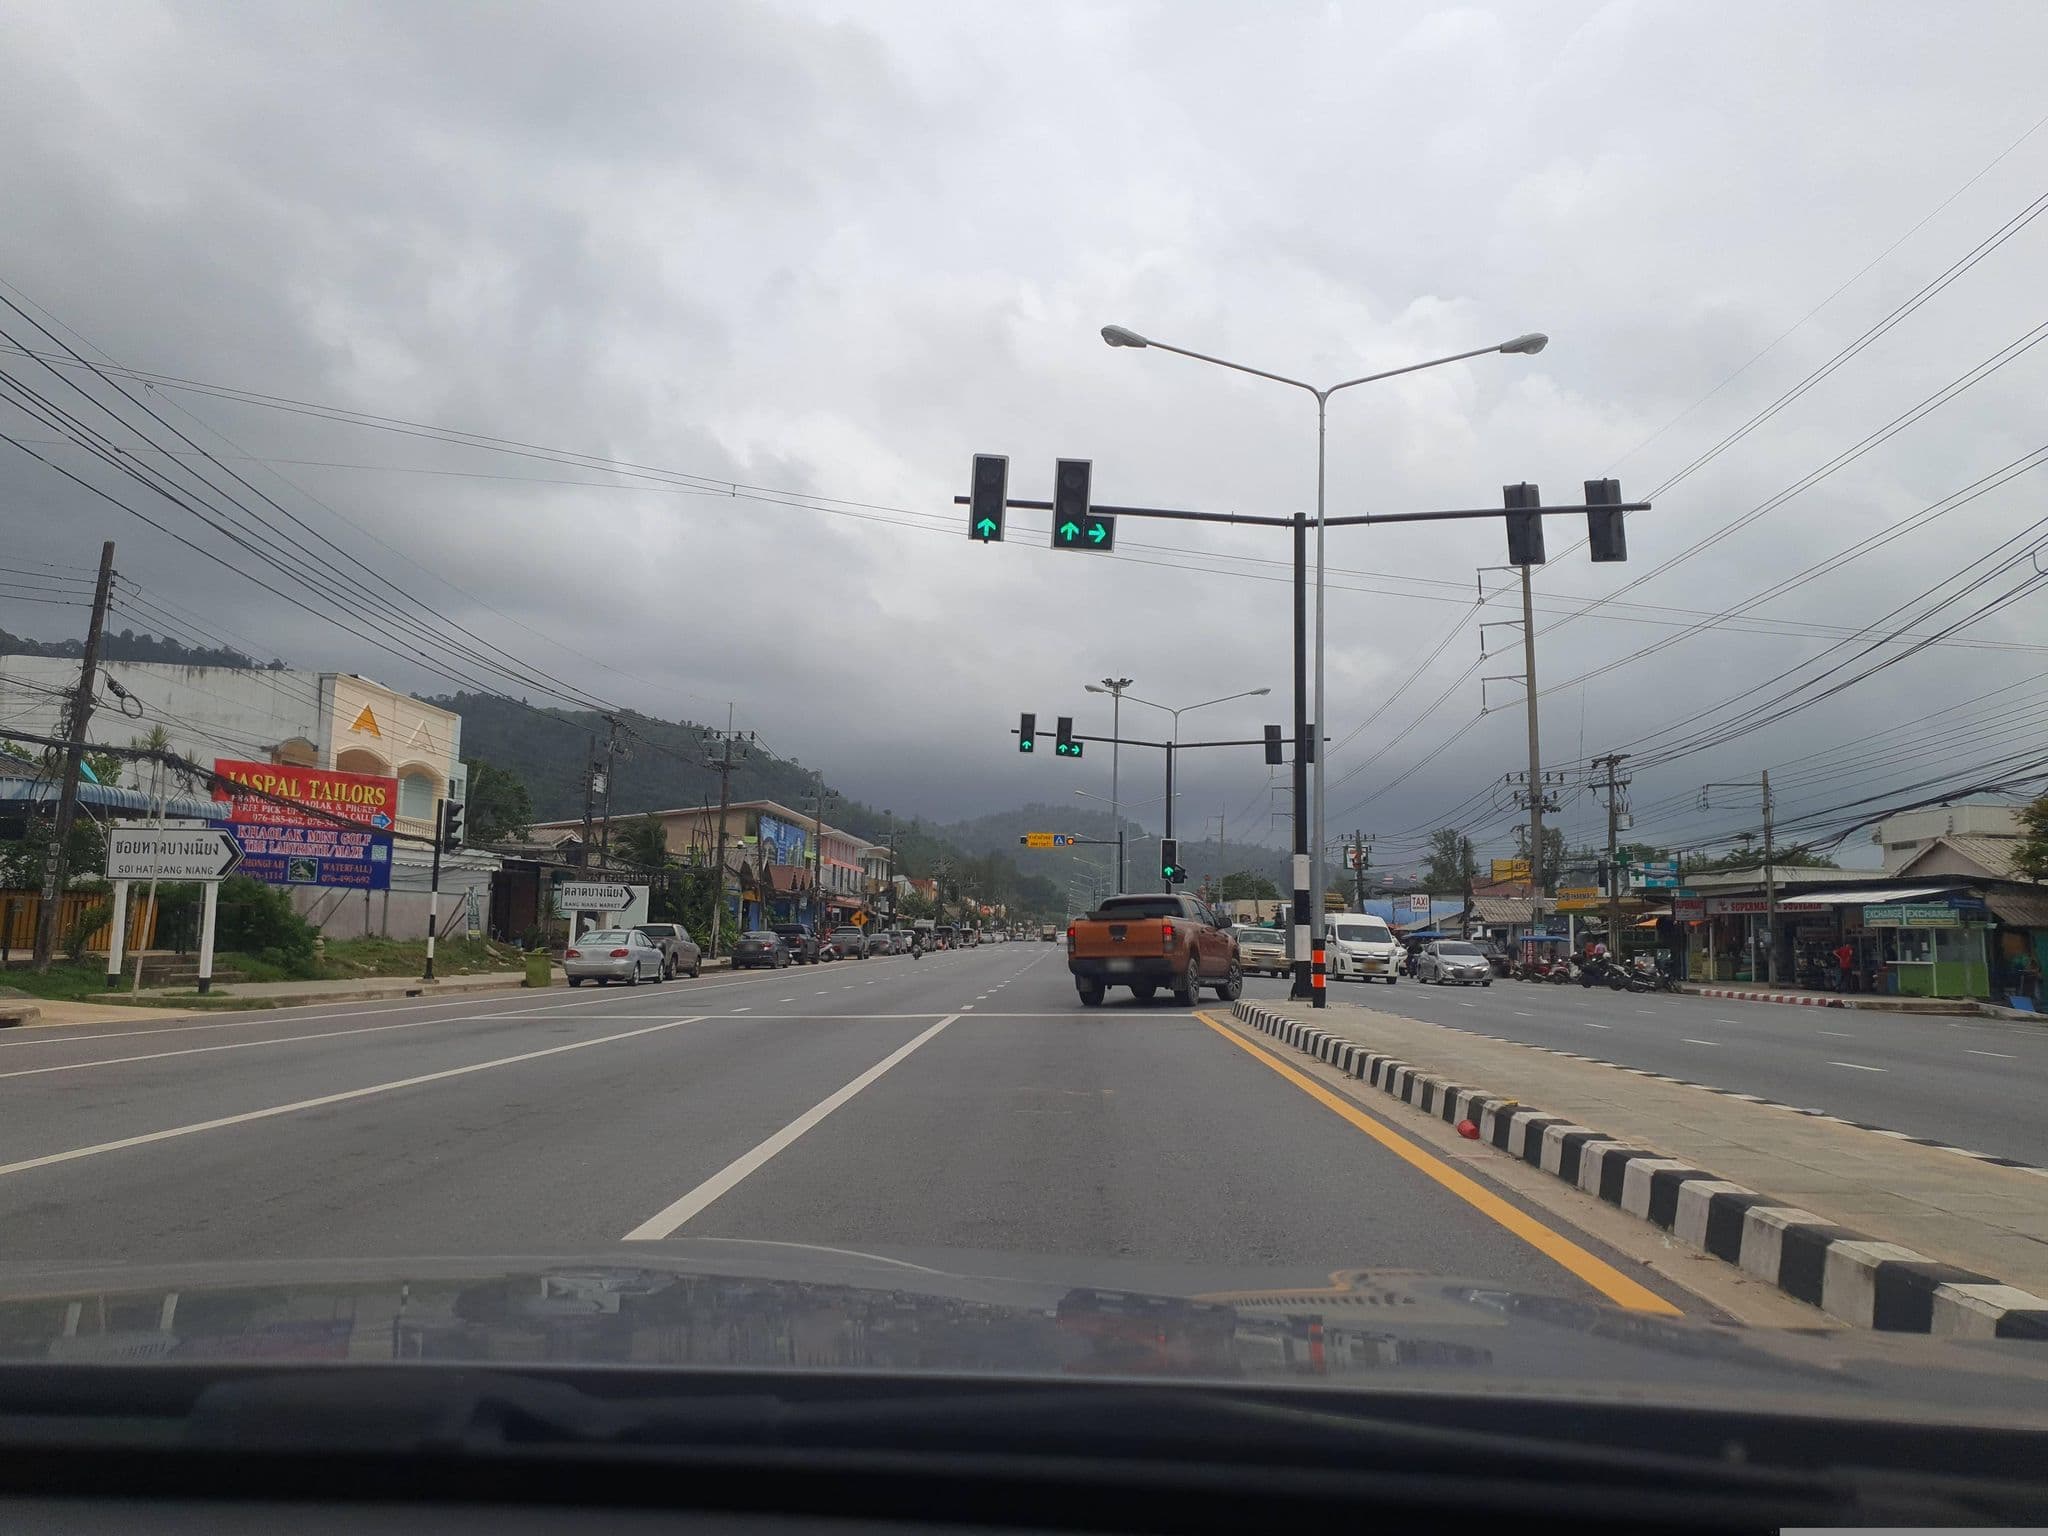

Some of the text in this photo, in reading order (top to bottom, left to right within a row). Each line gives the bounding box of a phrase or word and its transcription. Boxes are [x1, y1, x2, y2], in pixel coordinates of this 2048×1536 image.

[309, 780, 386, 806] TAILORS
[345, 804, 378, 814] PHUKET
[237, 825, 372, 846] KHAOLAK MINI GOLF
[118, 864, 214, 875] SOI HAT BANG NIANG
[1412, 897, 1428, 906] TAXI
[1865, 910, 1903, 918] EXCHANGE
[1907, 909, 1957, 918] EXCHANGE
